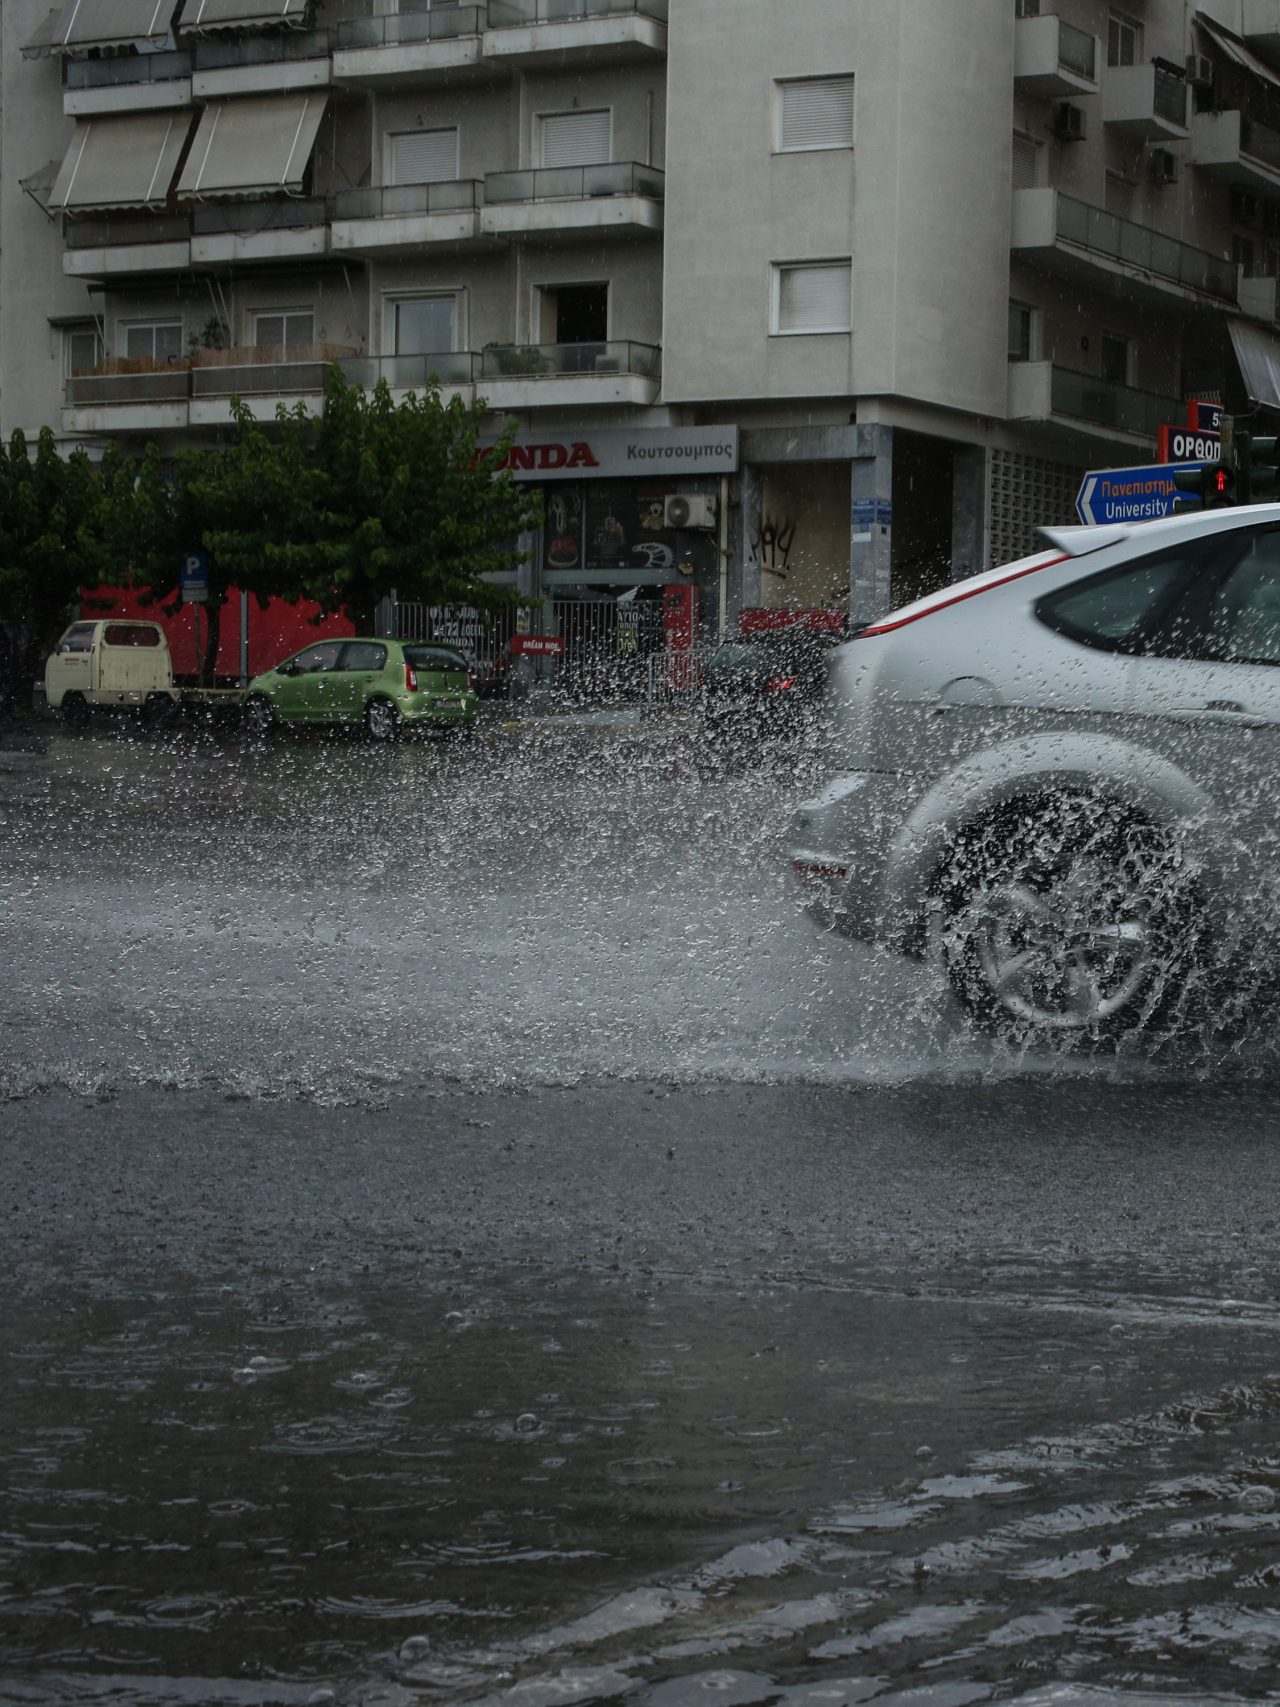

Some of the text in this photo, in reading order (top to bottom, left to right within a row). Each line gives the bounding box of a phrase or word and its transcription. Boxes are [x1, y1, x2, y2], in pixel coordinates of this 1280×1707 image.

[626, 442, 733, 461] Κουτσουμπός
[1105, 499, 1168, 519] University
[186, 556, 200, 575] P
